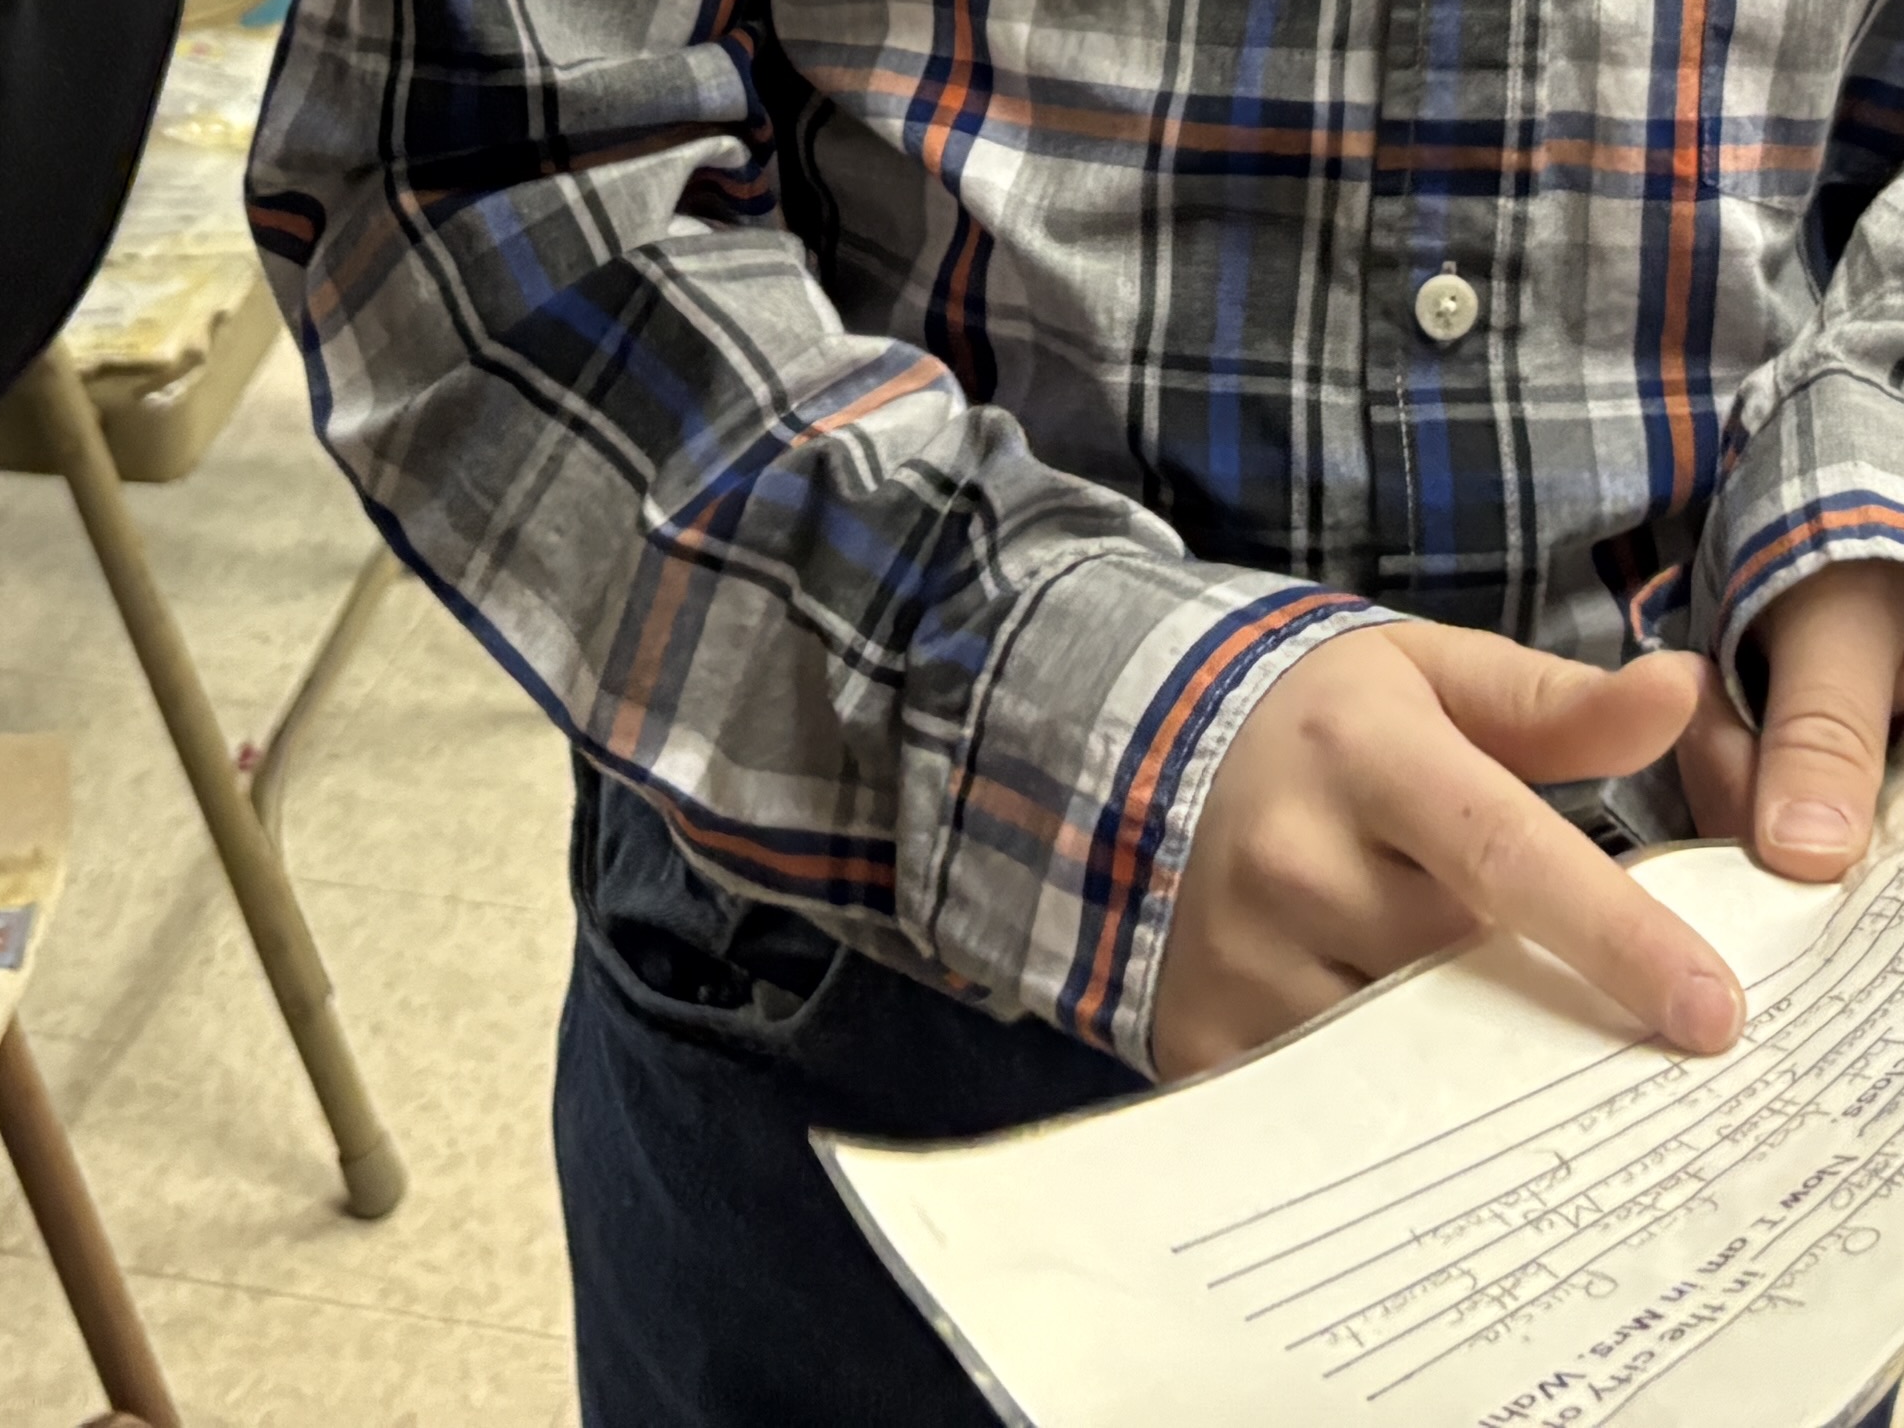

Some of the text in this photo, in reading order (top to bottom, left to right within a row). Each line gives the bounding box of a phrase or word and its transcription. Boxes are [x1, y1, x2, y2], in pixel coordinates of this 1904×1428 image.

[1779, 1155, 1859, 1211] Now
[1749, 1217, 1786, 1232] I
[1696, 1236, 1748, 1274] am
[1658, 1281, 1705, 1301] in
[1720, 1267, 1766, 1294] in
[1576, 1307, 1663, 1361] Mrs.
[1658, 1303, 1726, 1344] the
[1587, 1353, 1658, 1403] city
